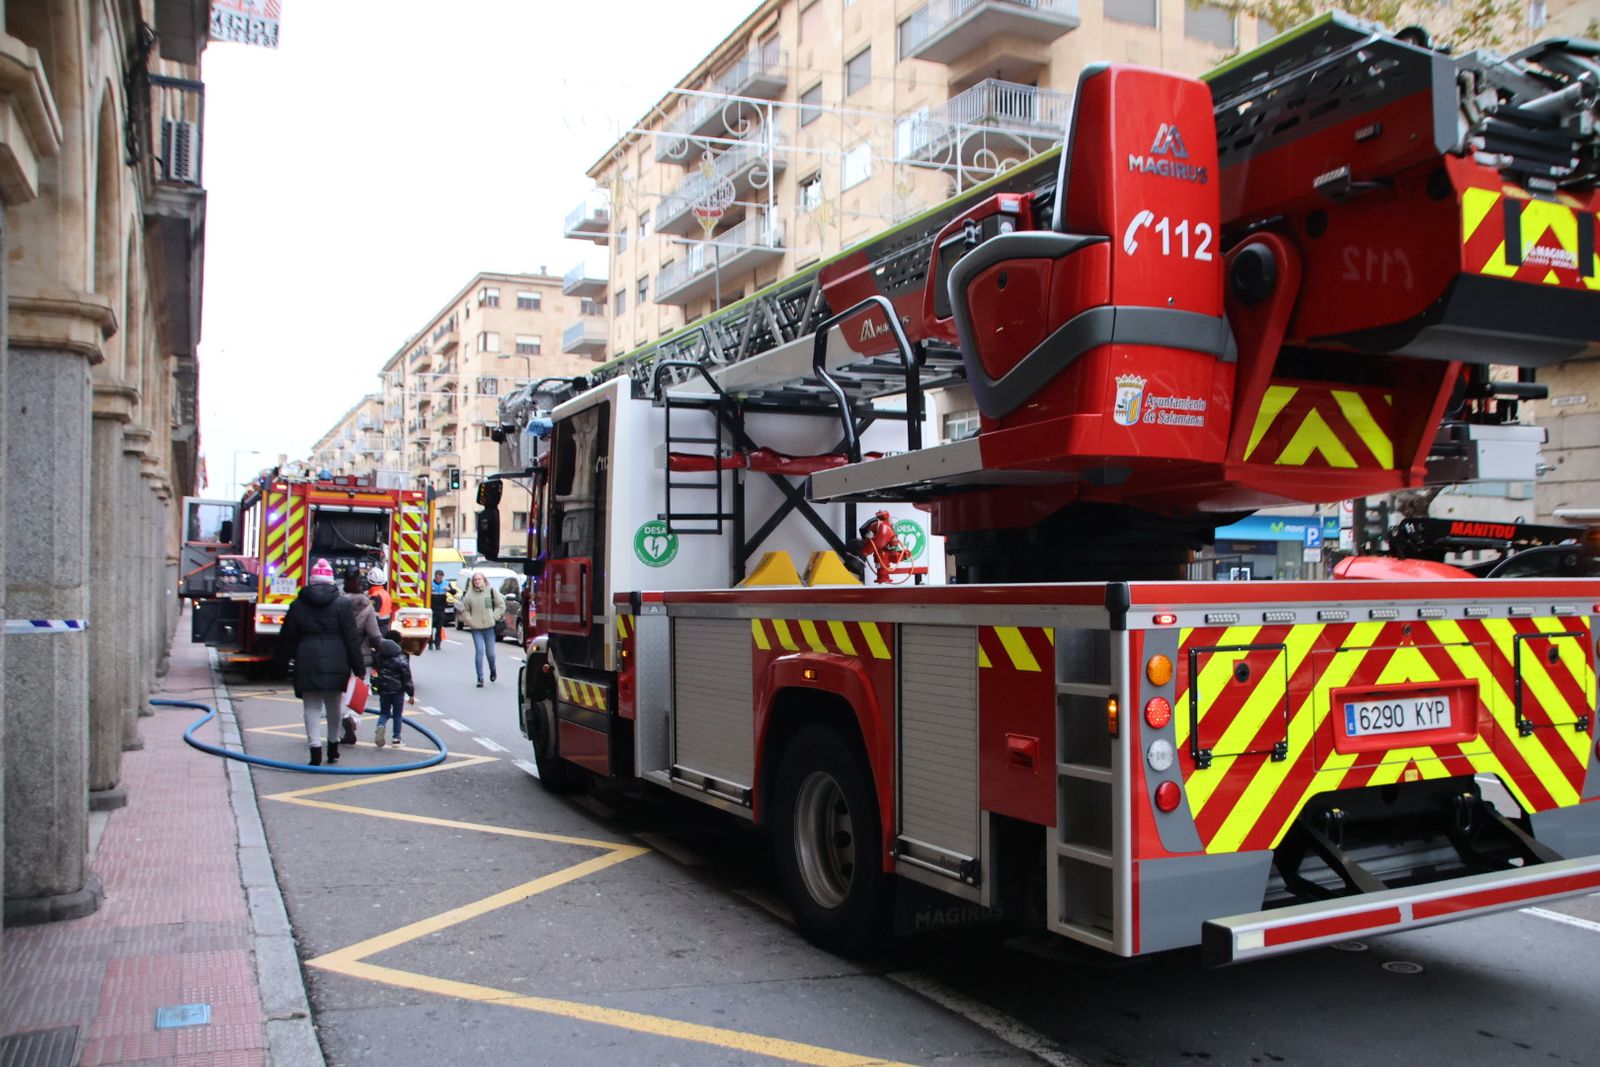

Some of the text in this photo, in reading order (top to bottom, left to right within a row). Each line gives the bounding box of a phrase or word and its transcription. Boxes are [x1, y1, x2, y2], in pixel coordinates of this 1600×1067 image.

[1128, 154, 1208, 184] MAGIRUS
[1155, 216, 1213, 262] 112
[1145, 393, 1206, 411] Ayuntamiento
[1143, 409, 1204, 427] de Salamanca
[644, 526, 669, 535] DESA
[1307, 528, 1319, 546] P
[1450, 521, 1517, 539] MANITOU
[1359, 700, 1445, 730] 6290 KYP
